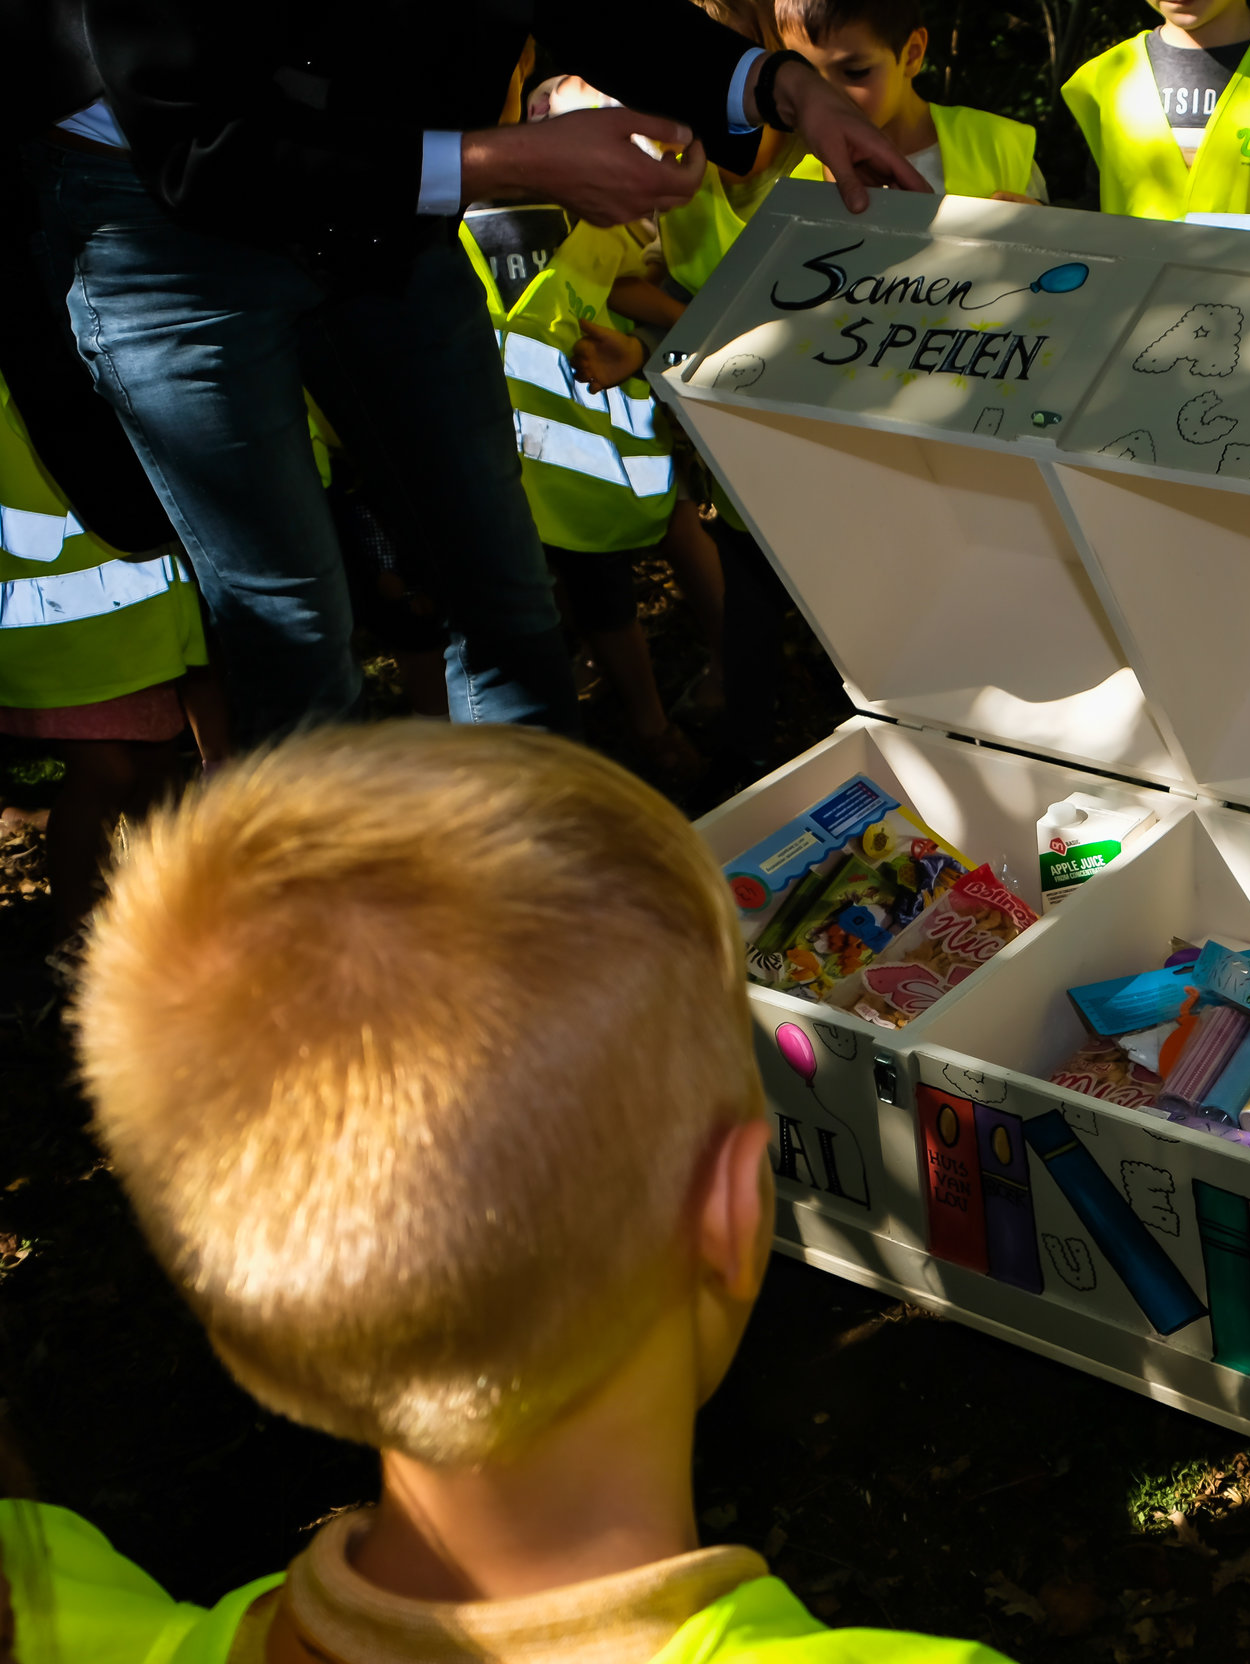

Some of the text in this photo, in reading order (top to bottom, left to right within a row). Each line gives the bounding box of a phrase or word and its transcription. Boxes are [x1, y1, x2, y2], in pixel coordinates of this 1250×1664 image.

[1161, 87, 1217, 115] TSID
[770, 239, 979, 311] Samen
[812, 316, 1050, 381] SPELEN
[1050, 854, 1106, 877] APPLE JUICE
[1054, 866, 1104, 883] FROM CONCENT
[774, 1111, 870, 1211] AL
[927, 1149, 969, 1178] HUIS
[934, 1169, 971, 1197] VAN
